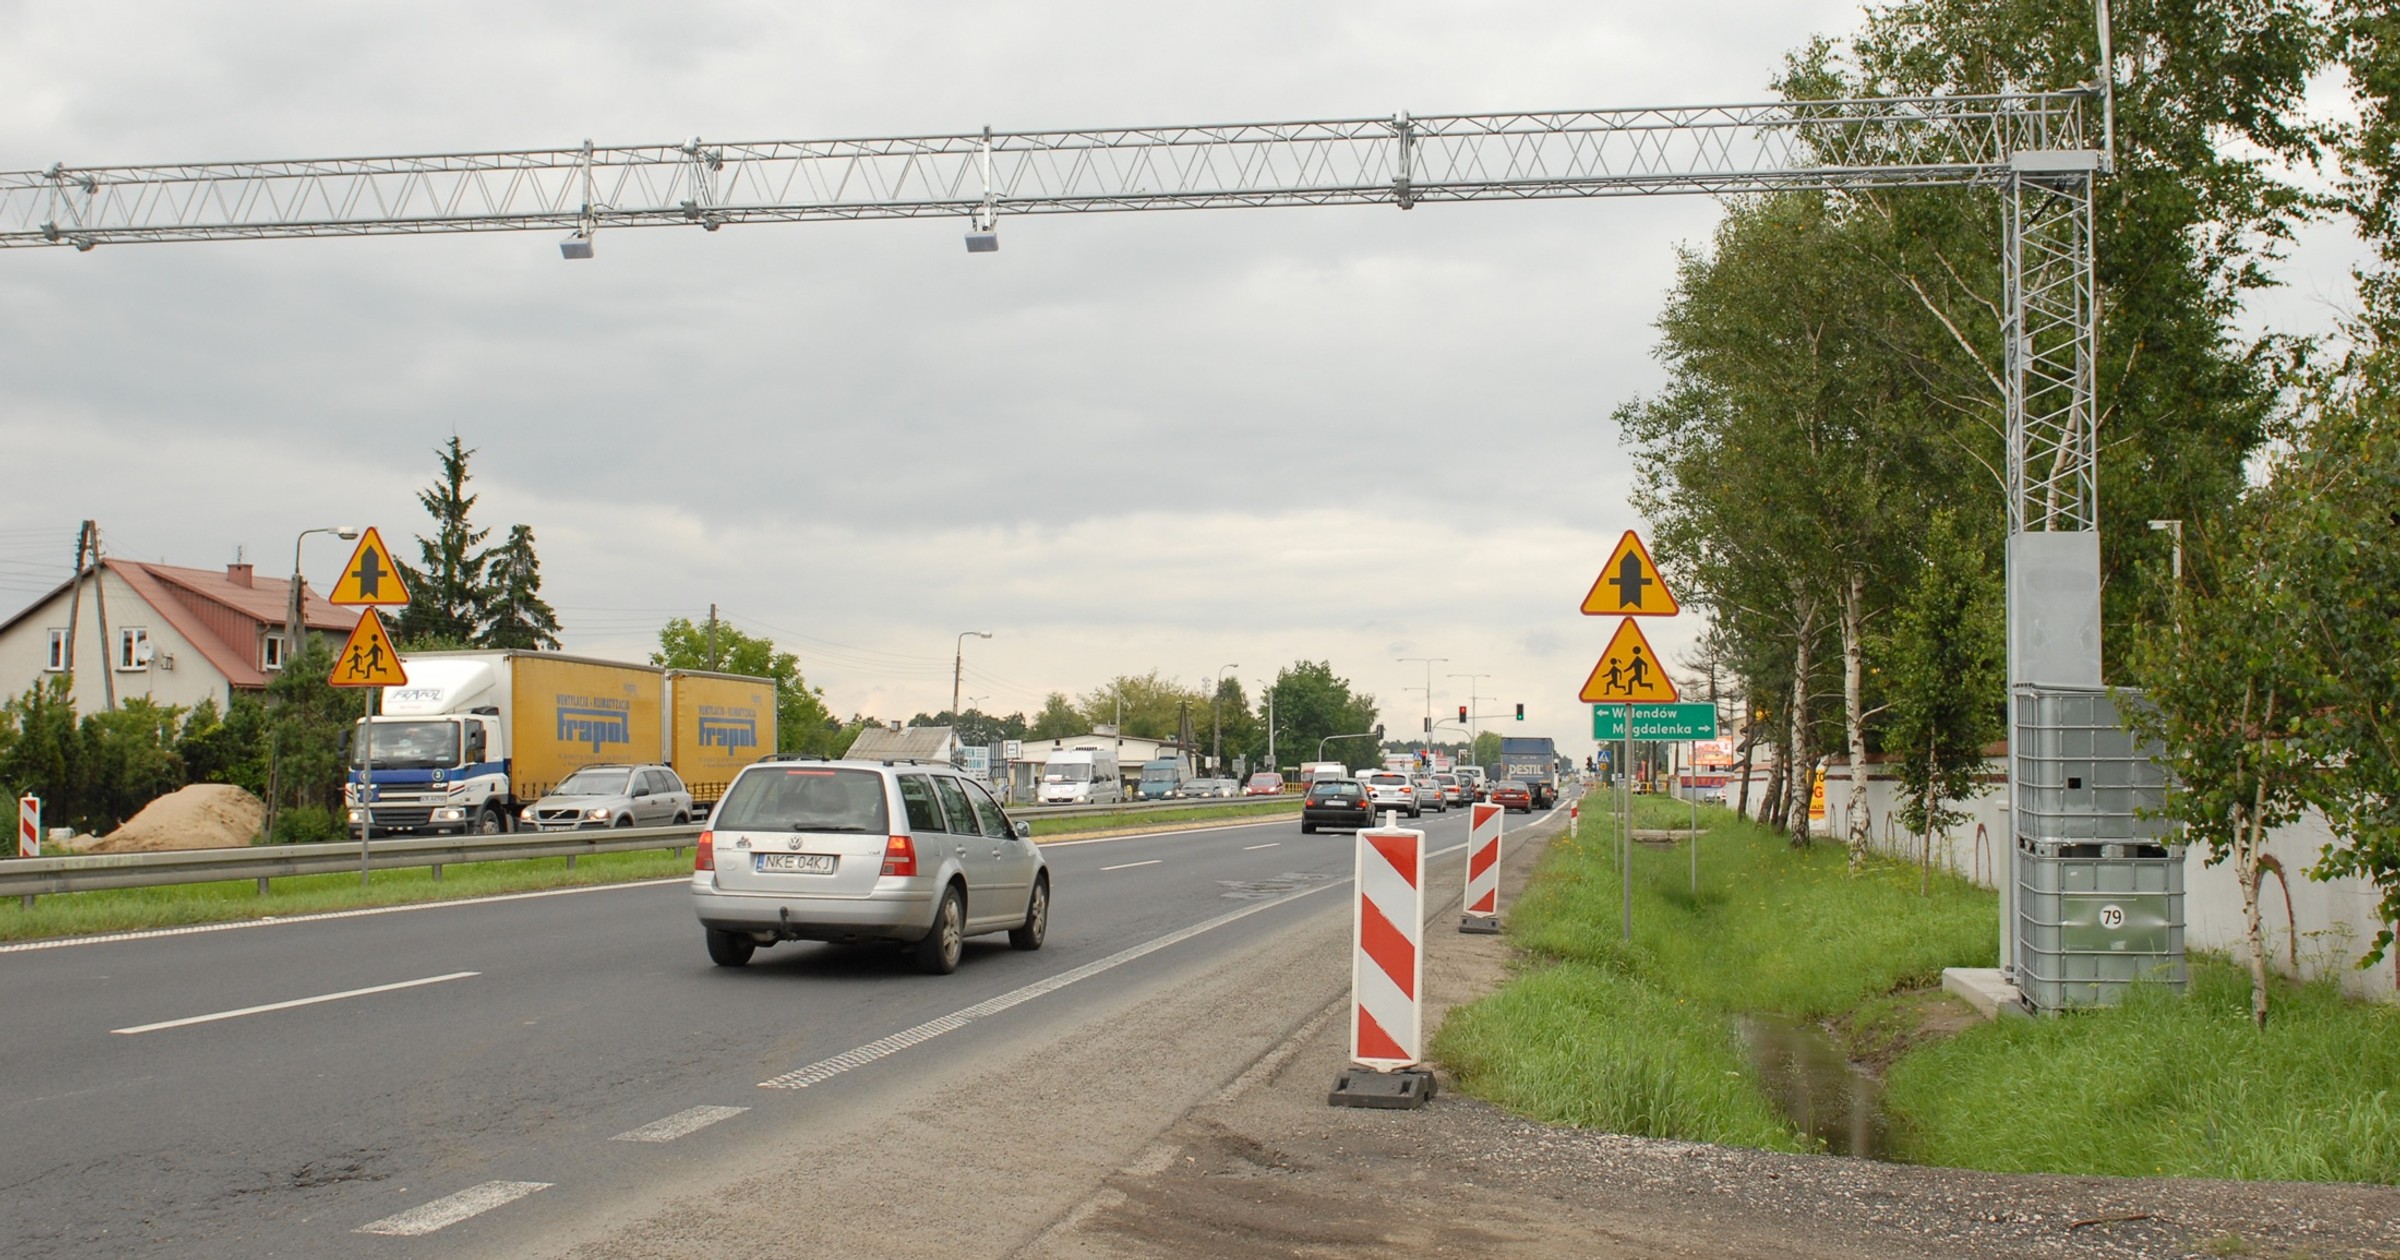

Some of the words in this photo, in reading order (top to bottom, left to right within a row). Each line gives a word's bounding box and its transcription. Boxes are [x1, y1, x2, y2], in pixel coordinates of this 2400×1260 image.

[393, 689, 441, 701] FRAPOL
[1612, 724, 1692, 737] Mgdalenka
[766, 855, 793, 868] NKE
[798, 856, 830, 870] 04KJ
[2103, 909, 2122, 925] 79
